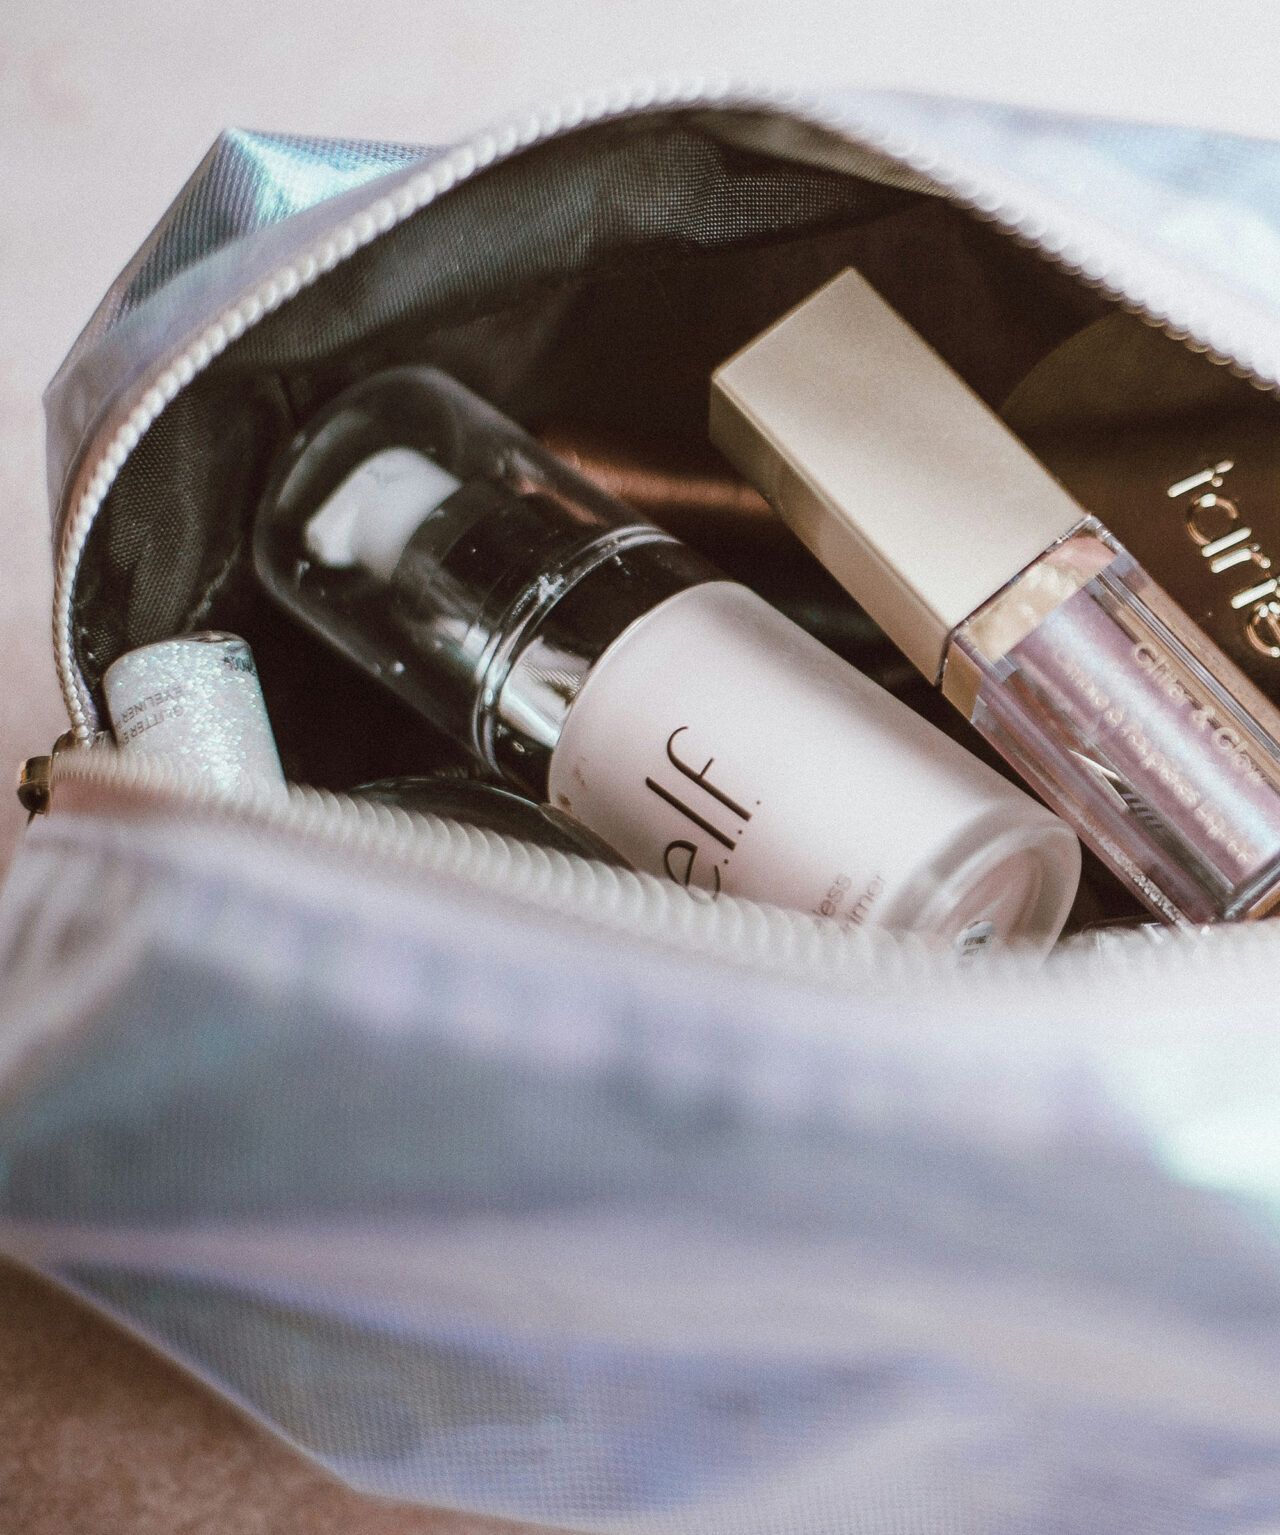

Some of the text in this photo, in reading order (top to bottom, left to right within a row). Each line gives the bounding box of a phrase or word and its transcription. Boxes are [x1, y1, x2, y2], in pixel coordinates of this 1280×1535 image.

[122, 685, 184, 724] EYELINER
[131, 705, 184, 738] GLITTER
[1192, 705, 1216, 730] &
[1212, 727, 1266, 783] Glow
